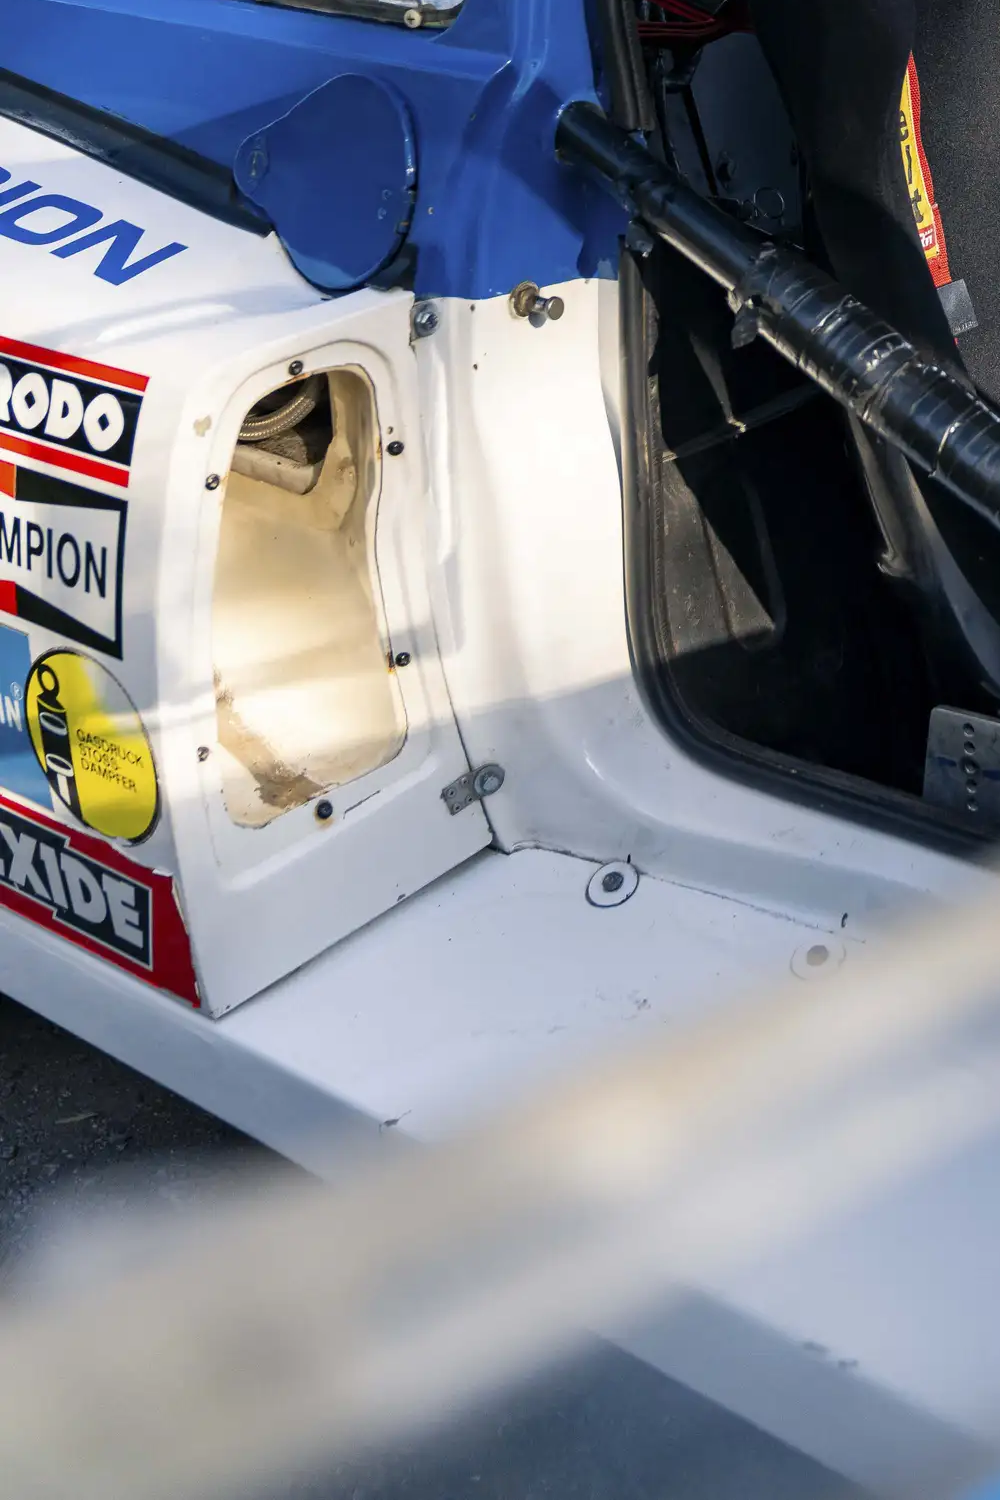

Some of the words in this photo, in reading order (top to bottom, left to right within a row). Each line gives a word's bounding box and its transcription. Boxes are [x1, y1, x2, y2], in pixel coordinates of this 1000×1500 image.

[0, 166, 189, 286] ION
[81, 757, 138, 793] DAMPFER
[0, 822, 145, 949] XIDE
